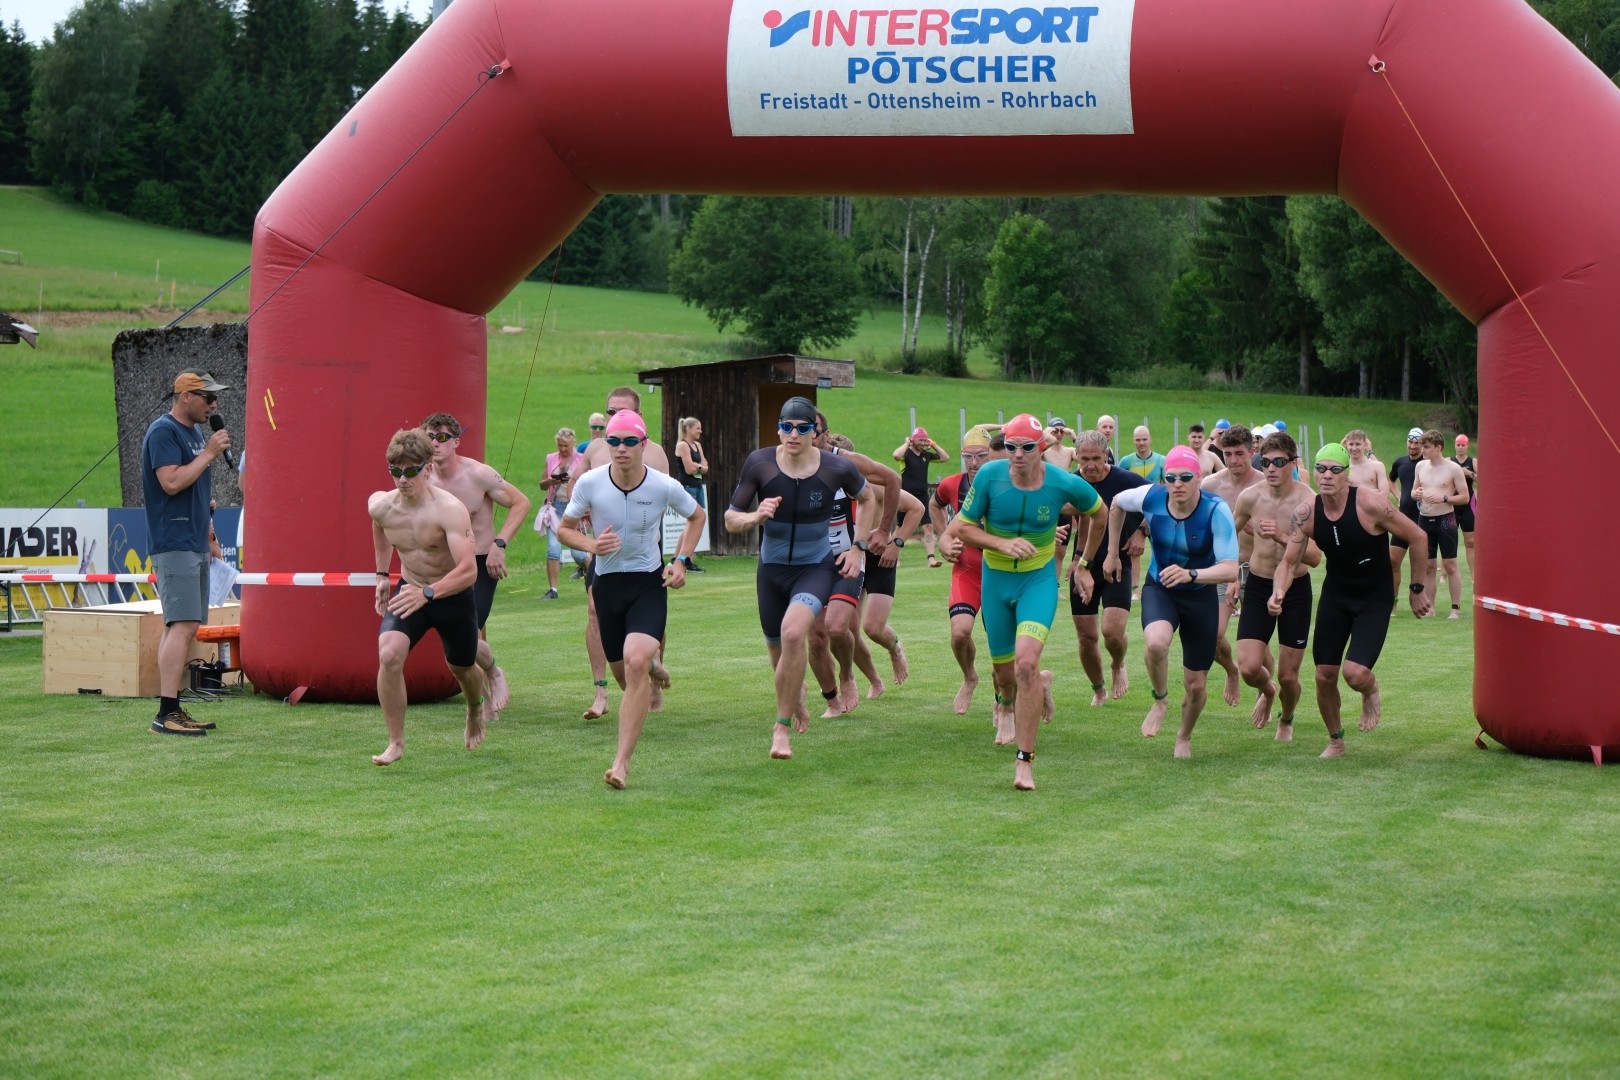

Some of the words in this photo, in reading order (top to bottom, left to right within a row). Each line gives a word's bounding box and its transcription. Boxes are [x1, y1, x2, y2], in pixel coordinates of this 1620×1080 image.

[811, 6, 1099, 47] INTERSPORT
[760, 92, 848, 110] Freistadt
[867, 92, 981, 109] Ottensheim
[1001, 90, 1097, 108] Rohrbach
